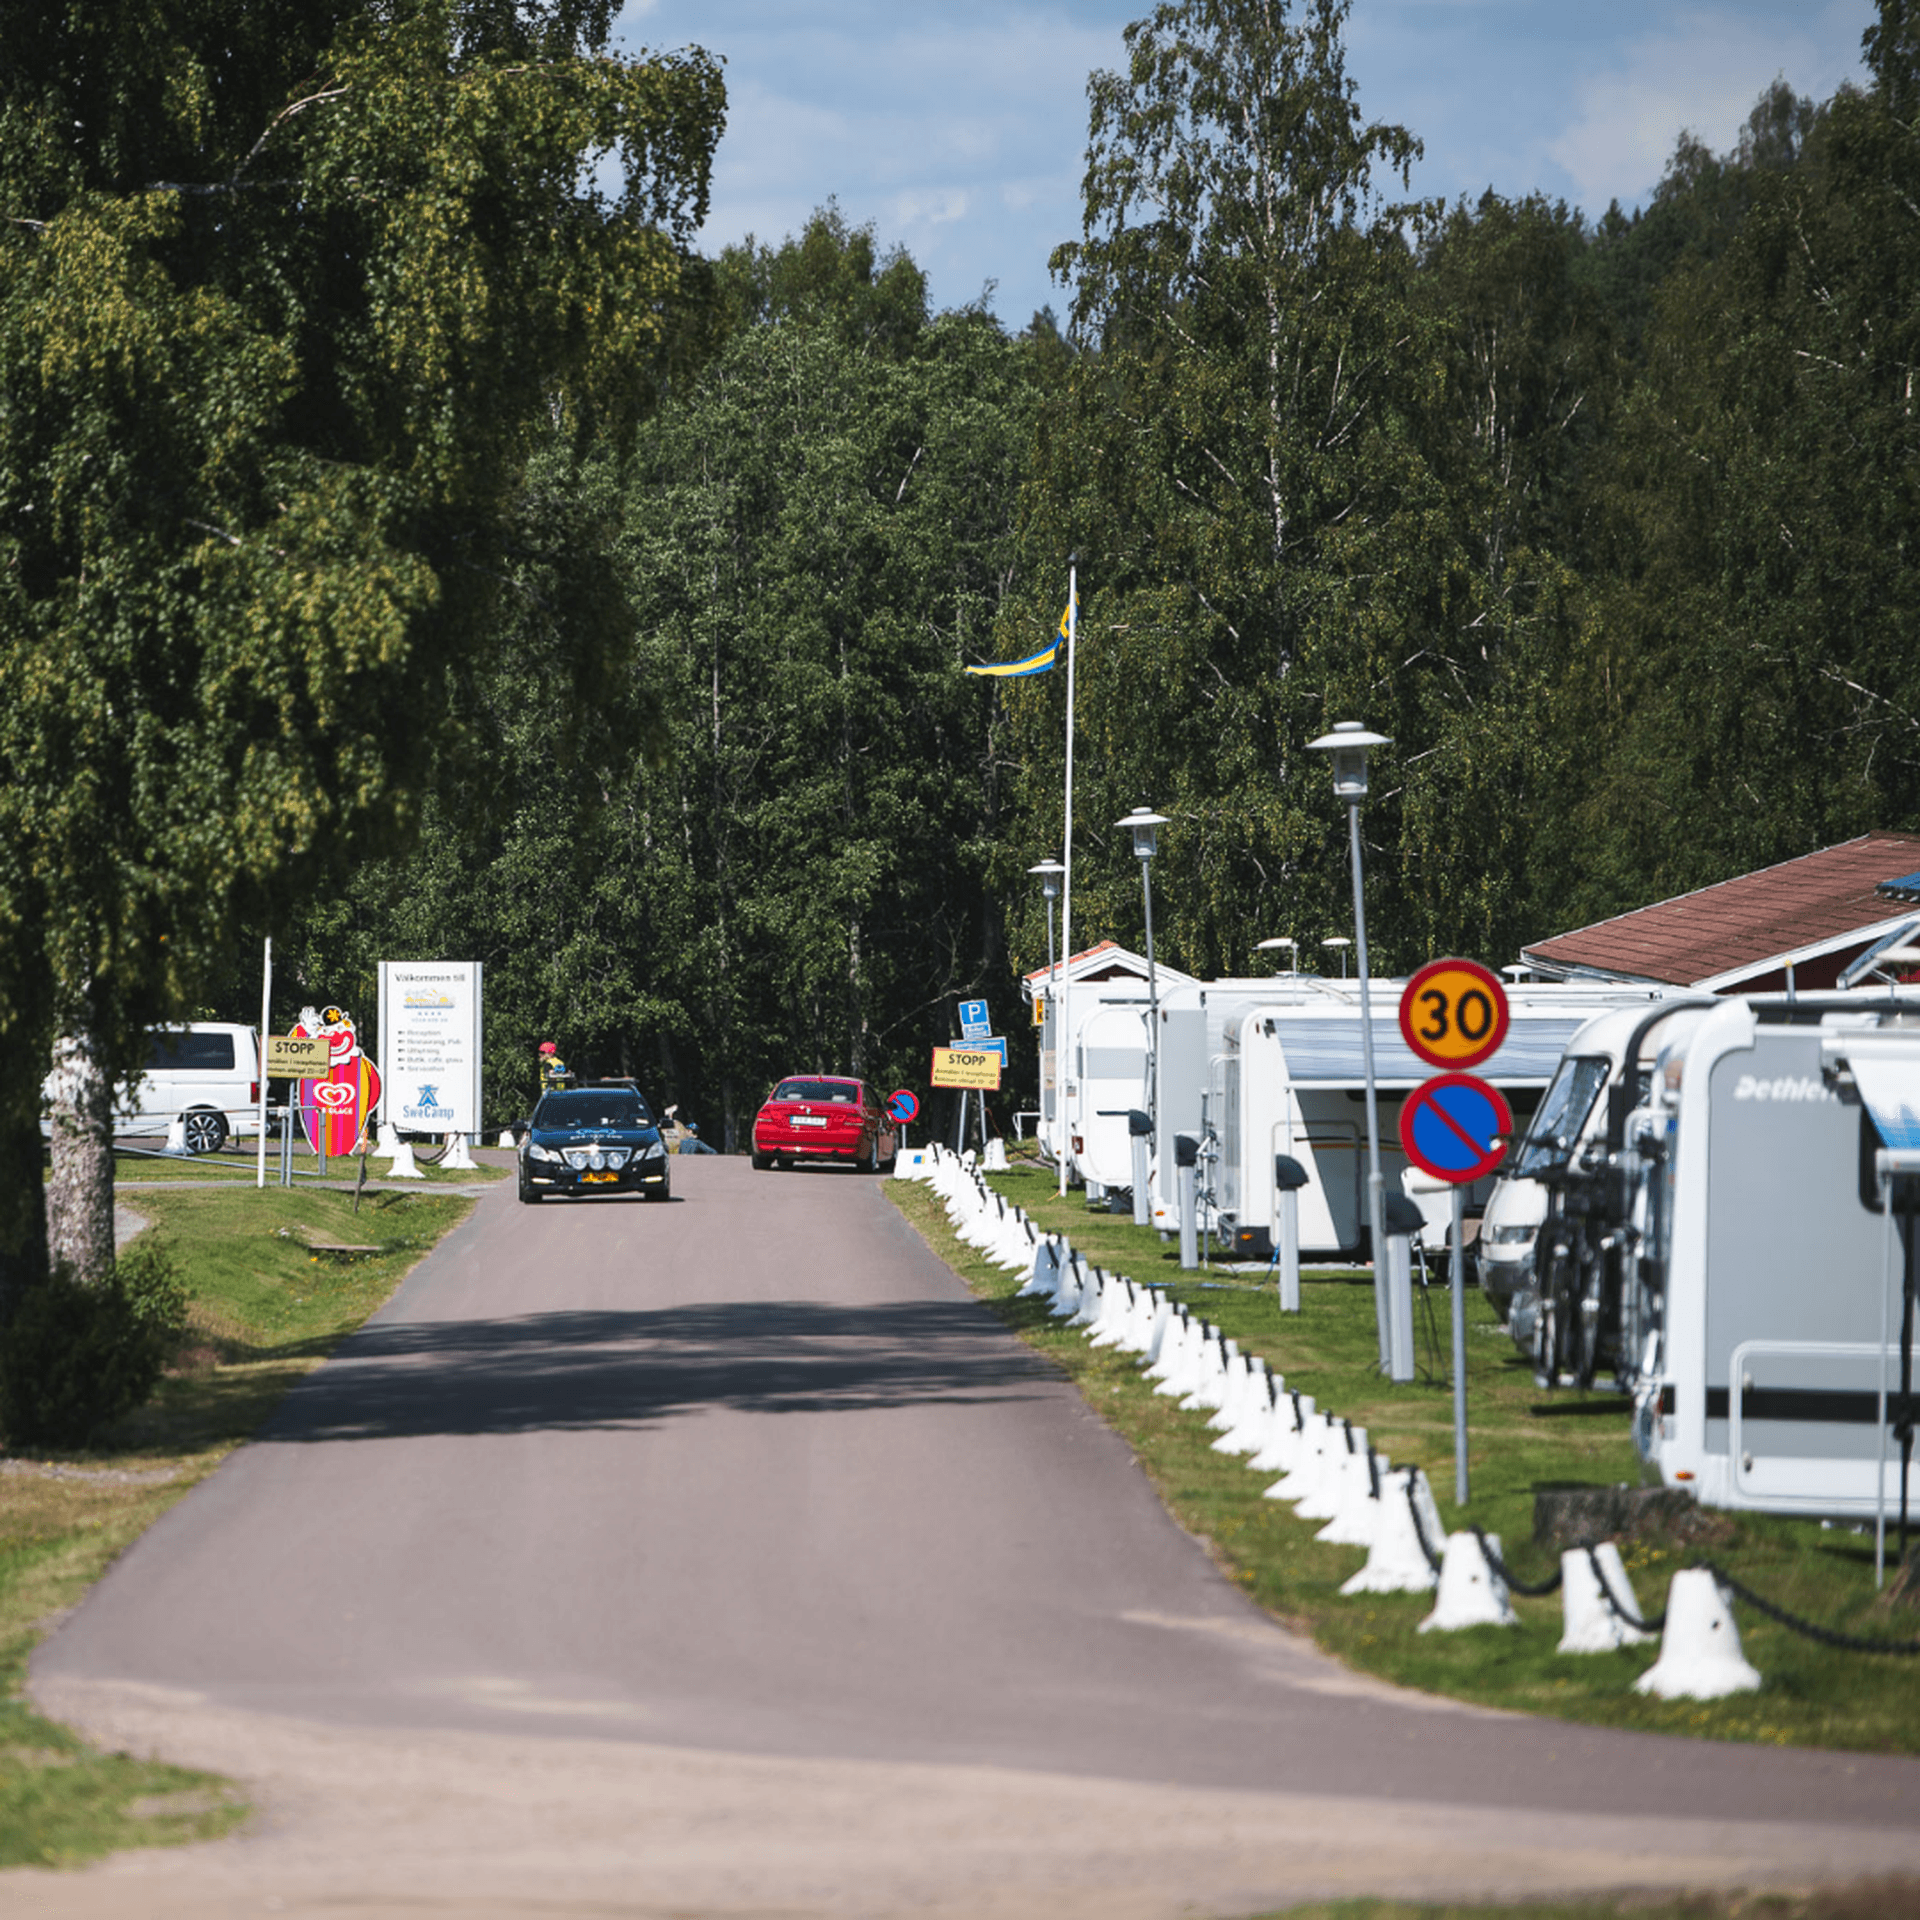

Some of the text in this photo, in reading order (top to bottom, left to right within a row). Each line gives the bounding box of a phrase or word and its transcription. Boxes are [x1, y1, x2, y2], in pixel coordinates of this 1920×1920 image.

[394, 973, 466, 982] Välkommen till
[968, 1004, 981, 1022] P
[1420, 988, 1493, 1041] 30
[275, 1041, 315, 1055] STOPP
[948, 1053, 986, 1066] STOPP
[328, 1106, 353, 1116] GLACE
[402, 1105, 454, 1121] SweCamp
